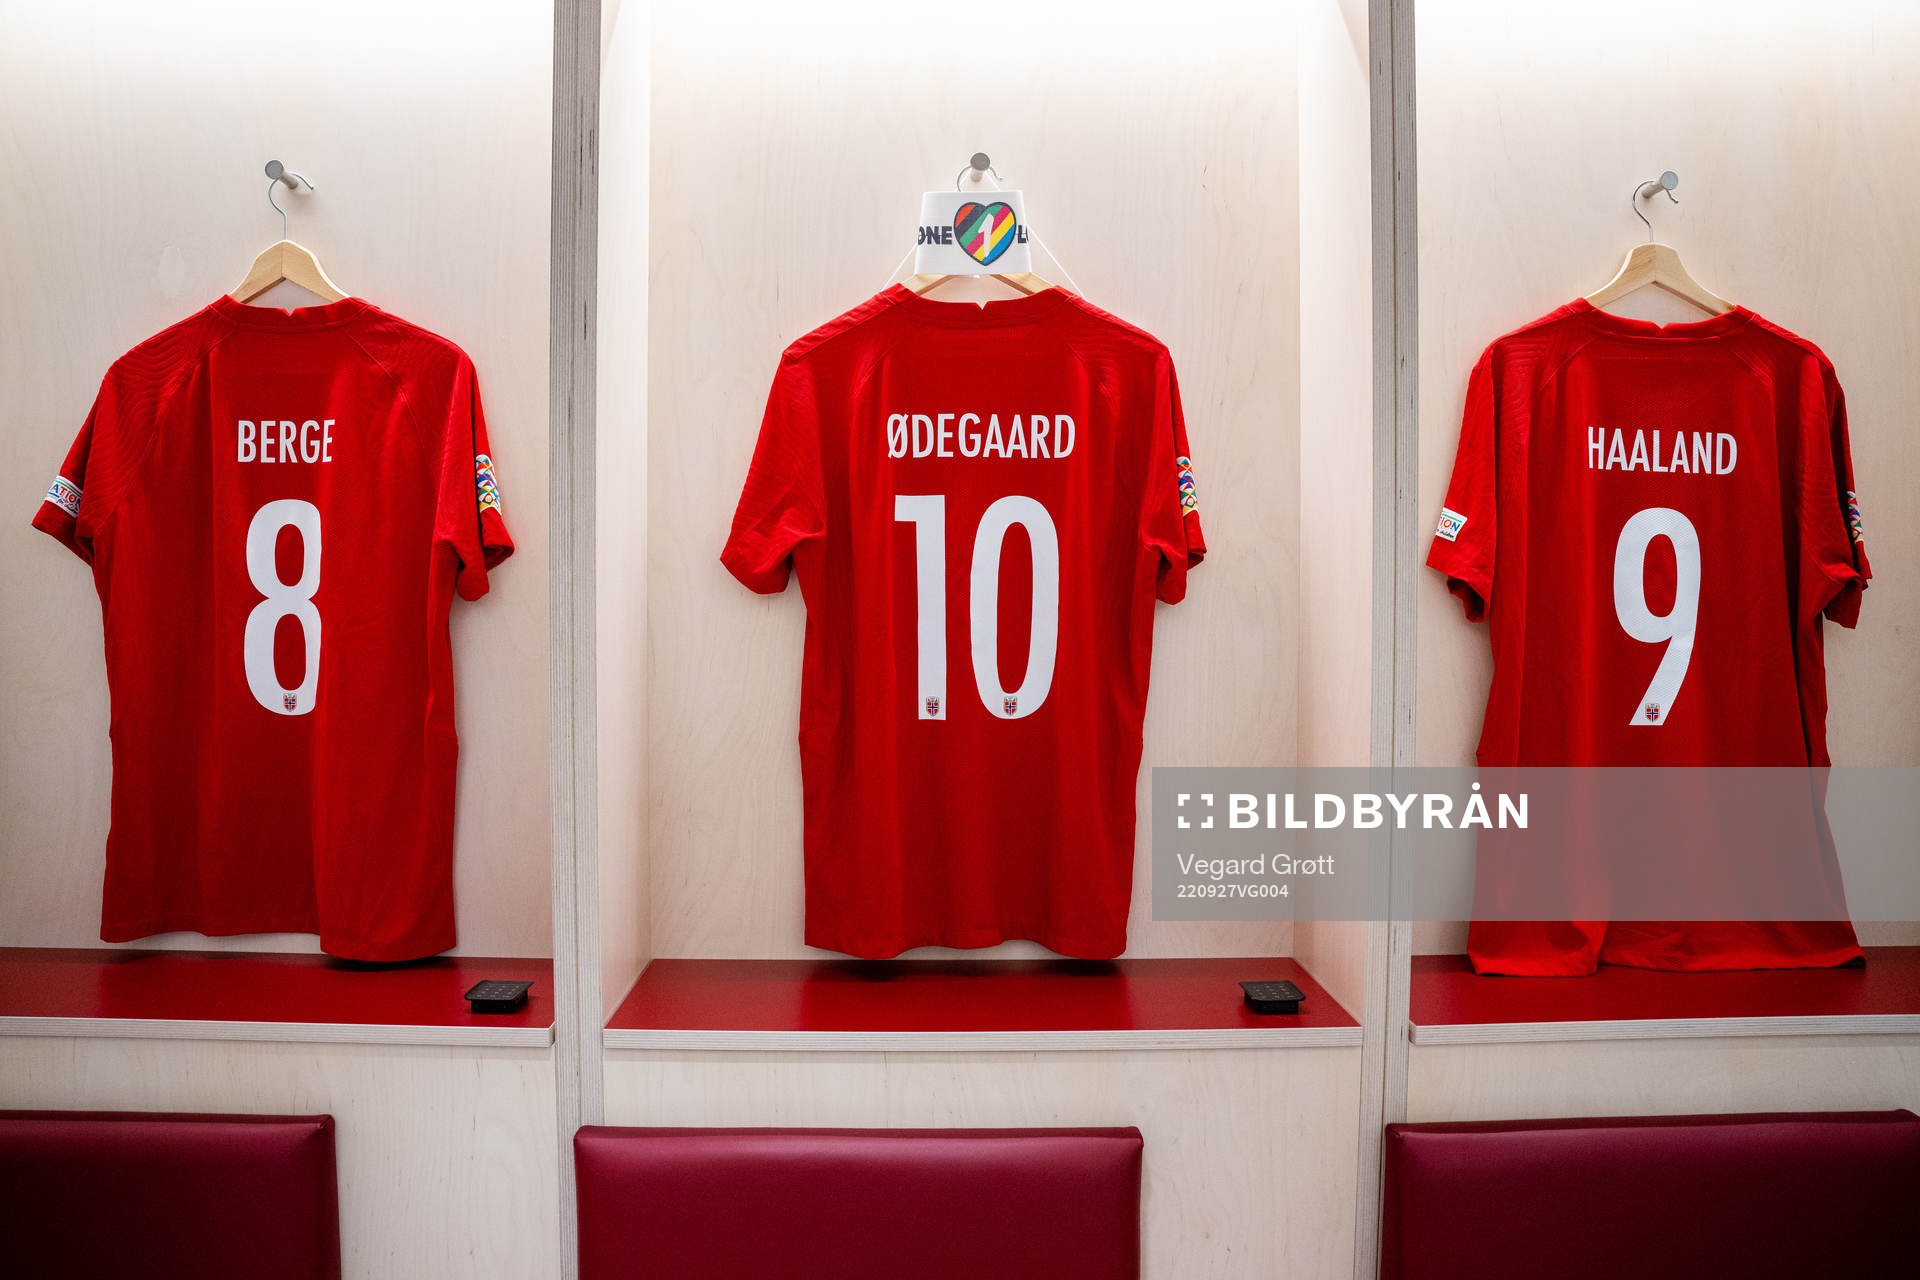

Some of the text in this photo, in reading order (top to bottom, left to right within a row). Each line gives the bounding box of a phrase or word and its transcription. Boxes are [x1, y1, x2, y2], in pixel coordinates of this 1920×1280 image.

[1017, 224, 1029, 244] L
[237, 419, 335, 464] BERGE
[886, 412, 1076, 460] ØDEGAARD
[1587, 426, 1738, 476] HAALAND
[243, 498, 323, 716] 8
[894, 494, 1060, 721] 10
[1613, 507, 1702, 727] 9
